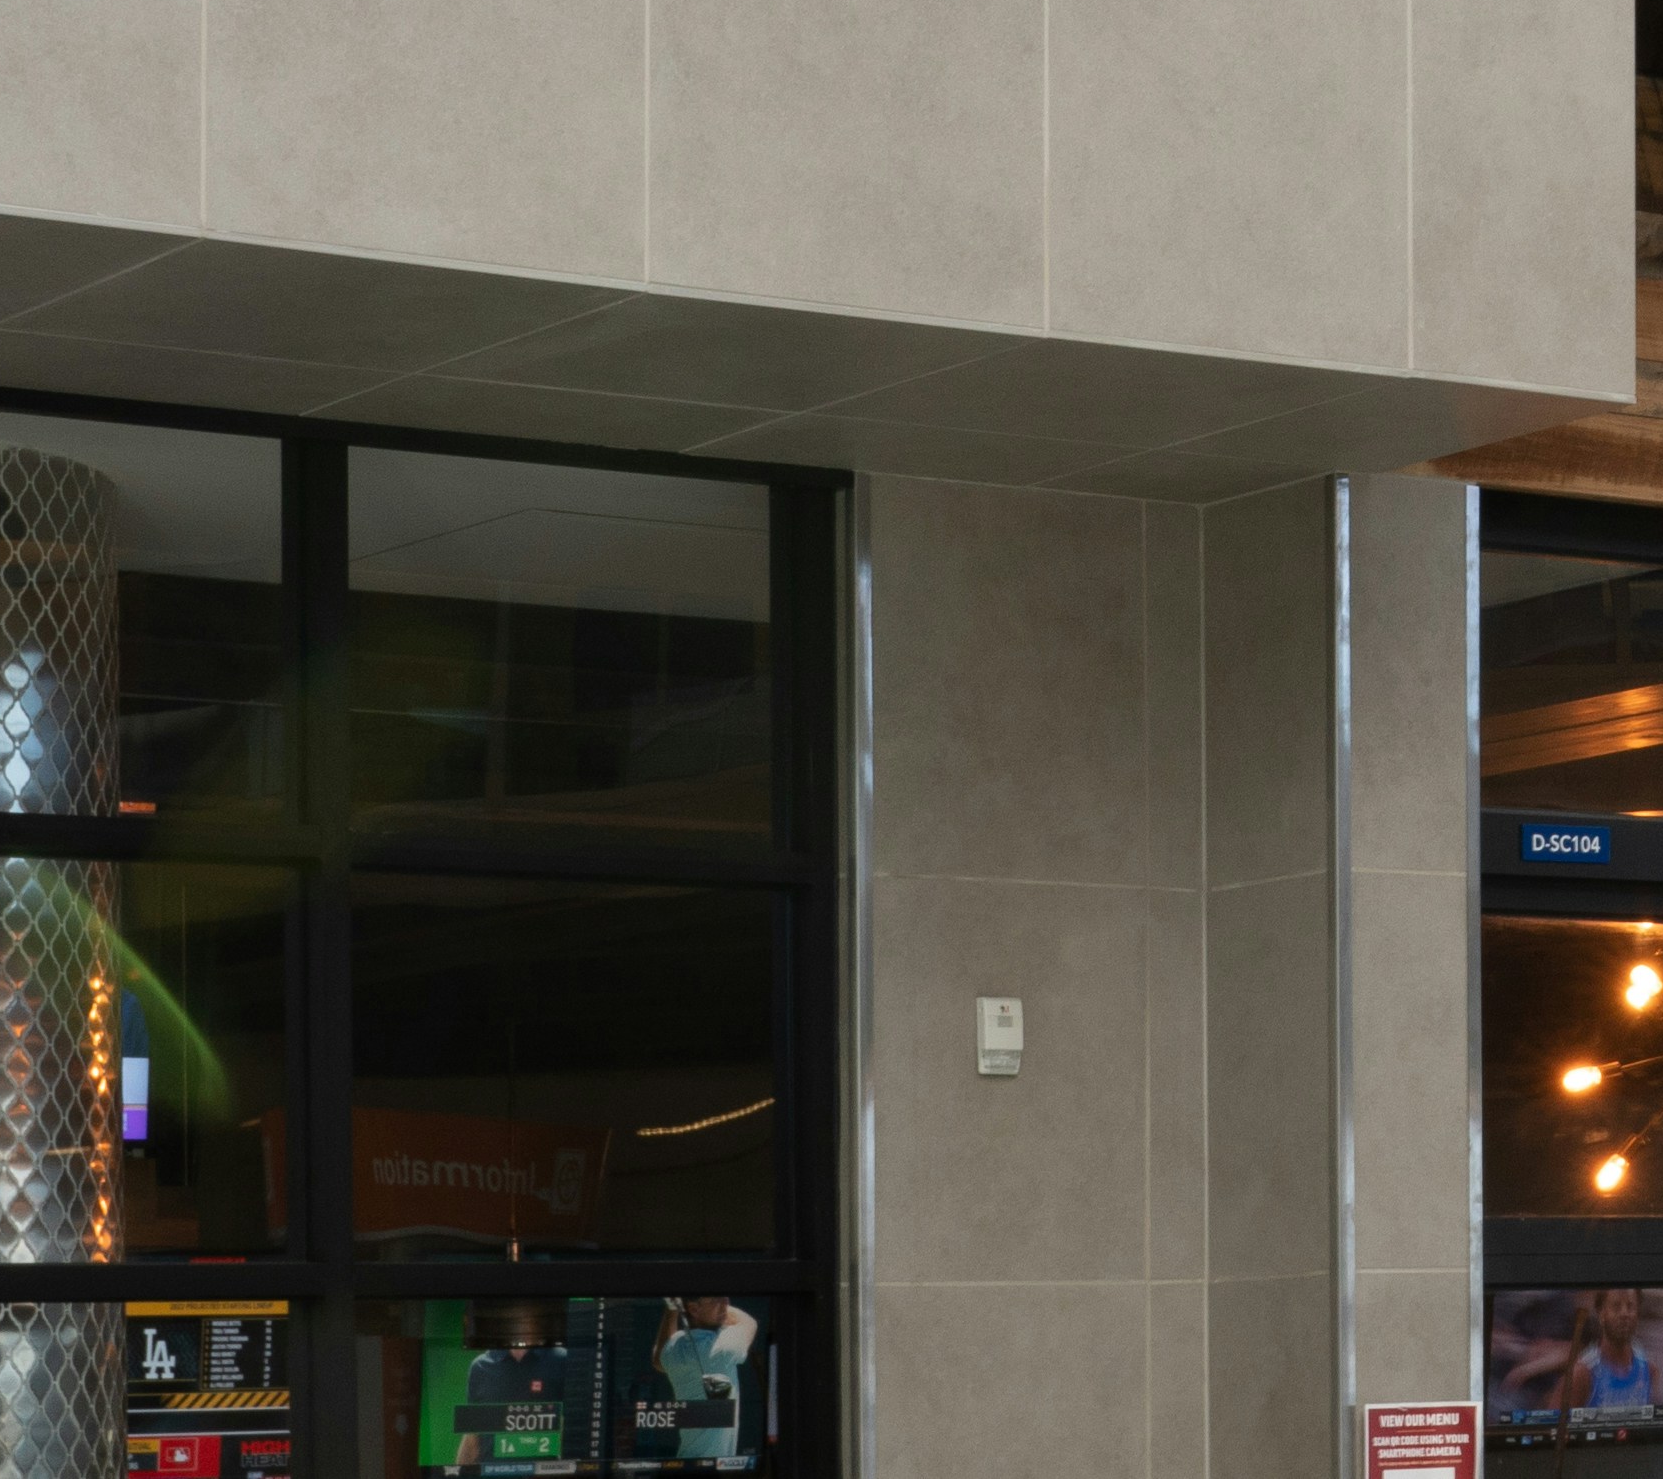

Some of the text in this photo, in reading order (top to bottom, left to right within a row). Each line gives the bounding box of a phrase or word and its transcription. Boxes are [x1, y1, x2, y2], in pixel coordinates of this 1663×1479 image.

[1531, 833, 1601, 853] D-SC104
[141, 1328, 176, 1379] LA
[505, 1413, 557, 1431] SCOTT
[635, 1410, 676, 1429] ROSE
[1379, 1412, 1460, 1428] VIEW OUR MENU
[241, 1440, 291, 1454] HIGH
[539, 1437, 550, 1452] 2
[1372, 1433, 1470, 1447] SCAN QR CODE USING YOUR
[1377, 1446, 1462, 1459] SMARTPHONE CAMERA
[241, 1454, 290, 1468] HEAT
